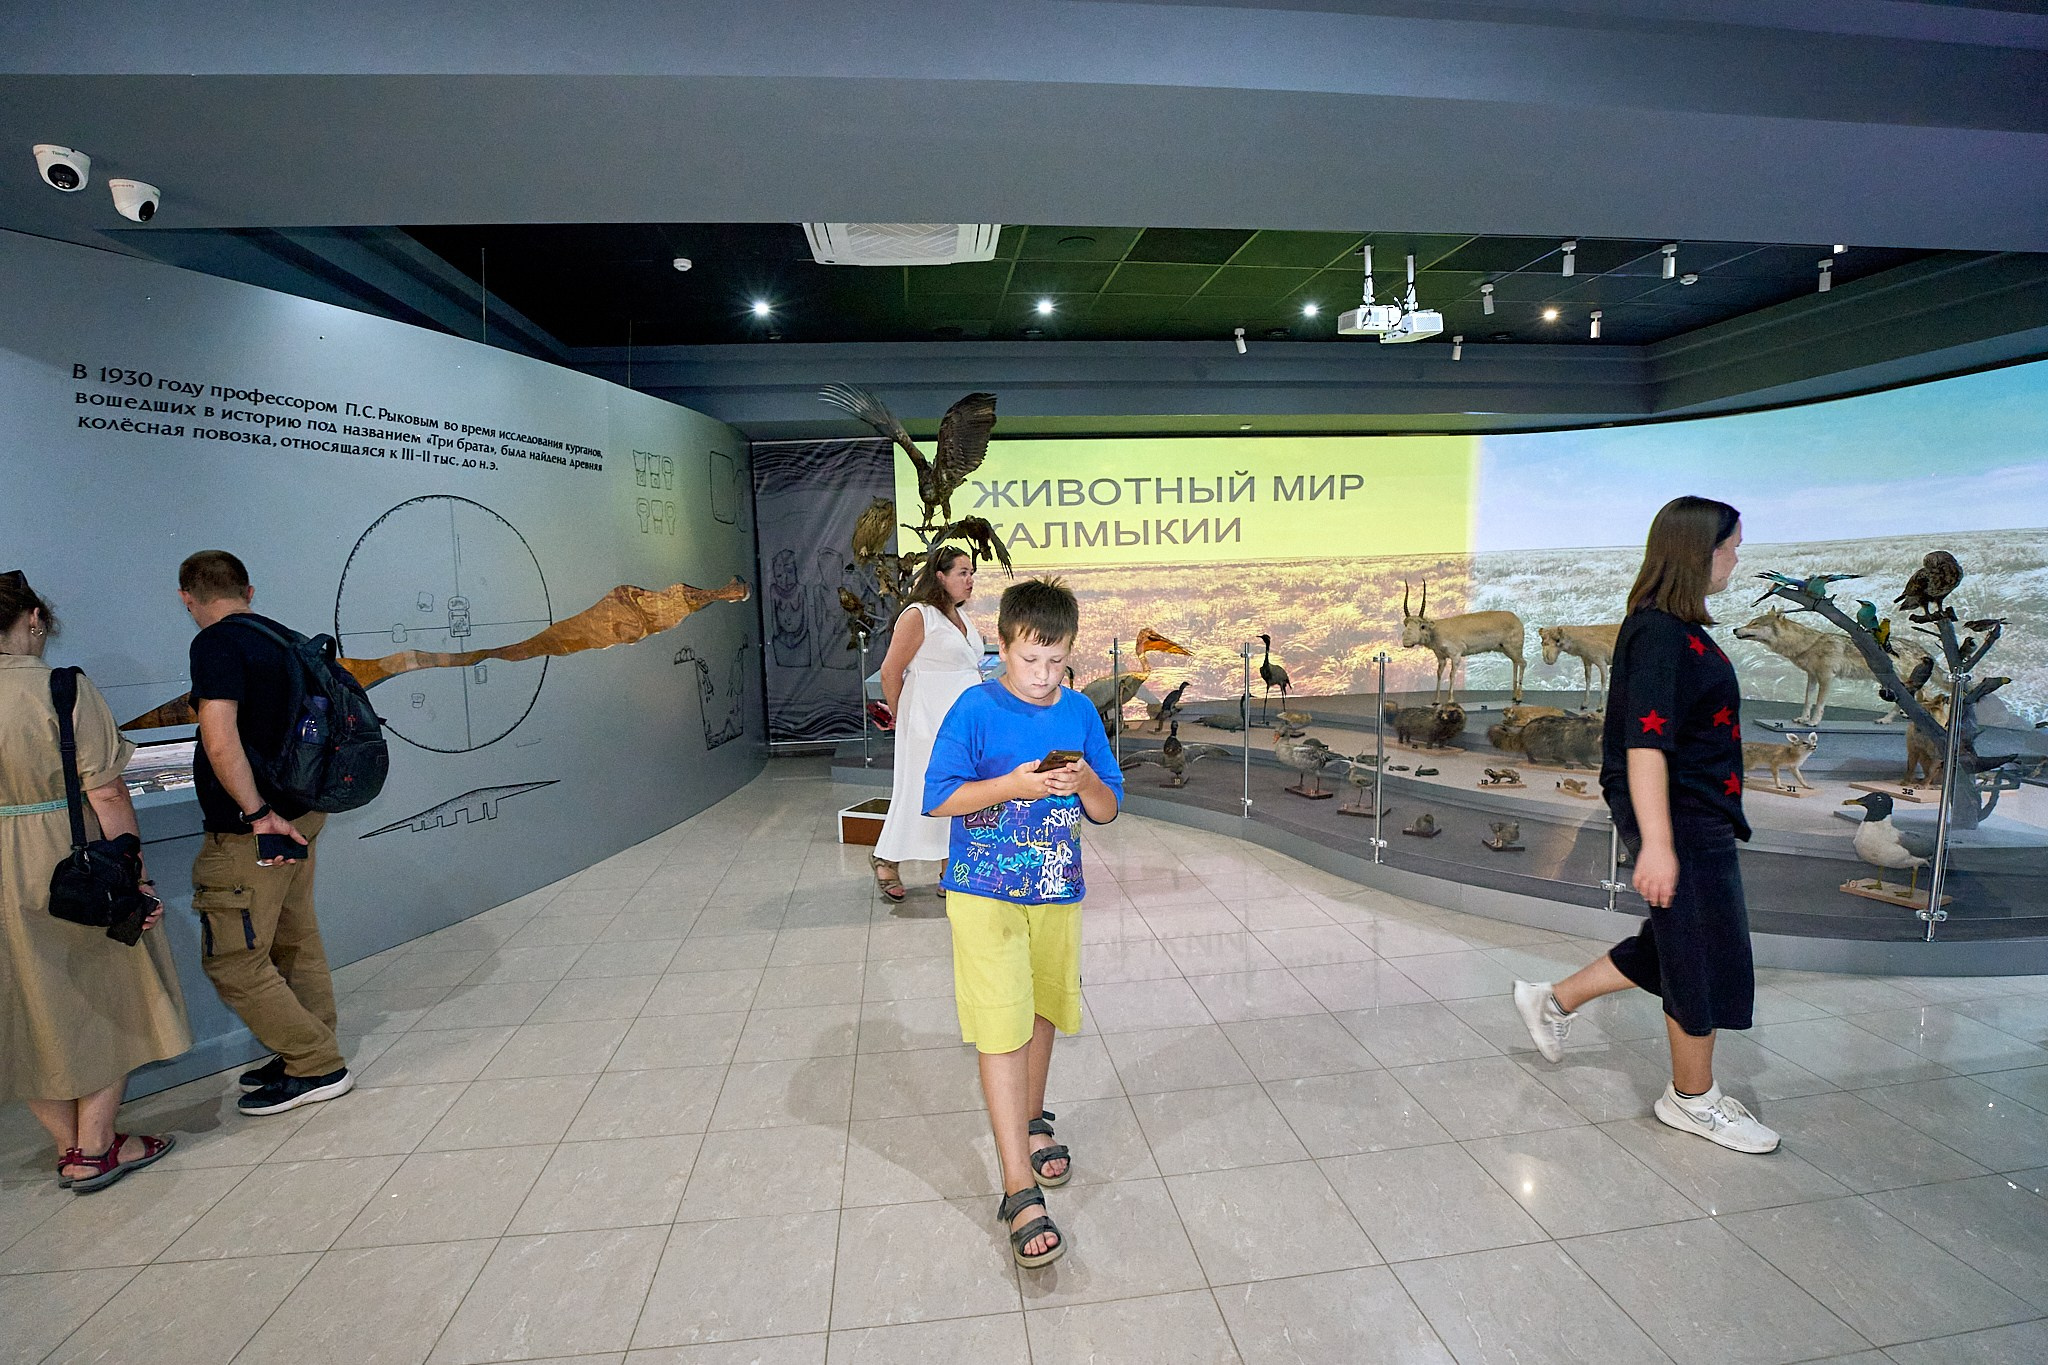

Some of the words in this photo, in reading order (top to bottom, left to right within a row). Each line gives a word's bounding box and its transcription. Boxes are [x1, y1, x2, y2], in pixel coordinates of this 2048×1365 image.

[71, 362, 88, 380] В
[98, 366, 154, 388] 1930
[157, 378, 205, 399] году
[210, 386, 338, 414] профессором
[443, 420, 459, 432] во
[460, 423, 497, 438] время
[498, 430, 564, 450] исследования
[565, 442, 604, 460] курганов,
[74, 391, 197, 417] вошедших
[203, 406, 215, 418] в
[220, 408, 302, 429] историю
[307, 419, 338, 434] под
[342, 424, 422, 445] названием
[426, 433, 454, 450] «Три
[456, 437, 498, 456] брата»,
[500, 444, 527, 459] была
[528, 450, 567, 466] найдена
[568, 458, 603, 472] древняя
[76, 415, 185, 438] колёсная
[192, 427, 278, 448] повозка,
[279, 436, 386, 458] относящаяся
[389, 449, 399, 460] к
[433, 454, 460, 467] тыс.
[461, 458, 477, 470] до
[478, 459, 499, 471] н.э.
[971, 470, 1256, 509] ЖИВОТНЫЙ
[1273, 474, 1365, 502] МИР
[1786, 785, 1797, 793] 31
[1901, 787, 1914, 796] 32
